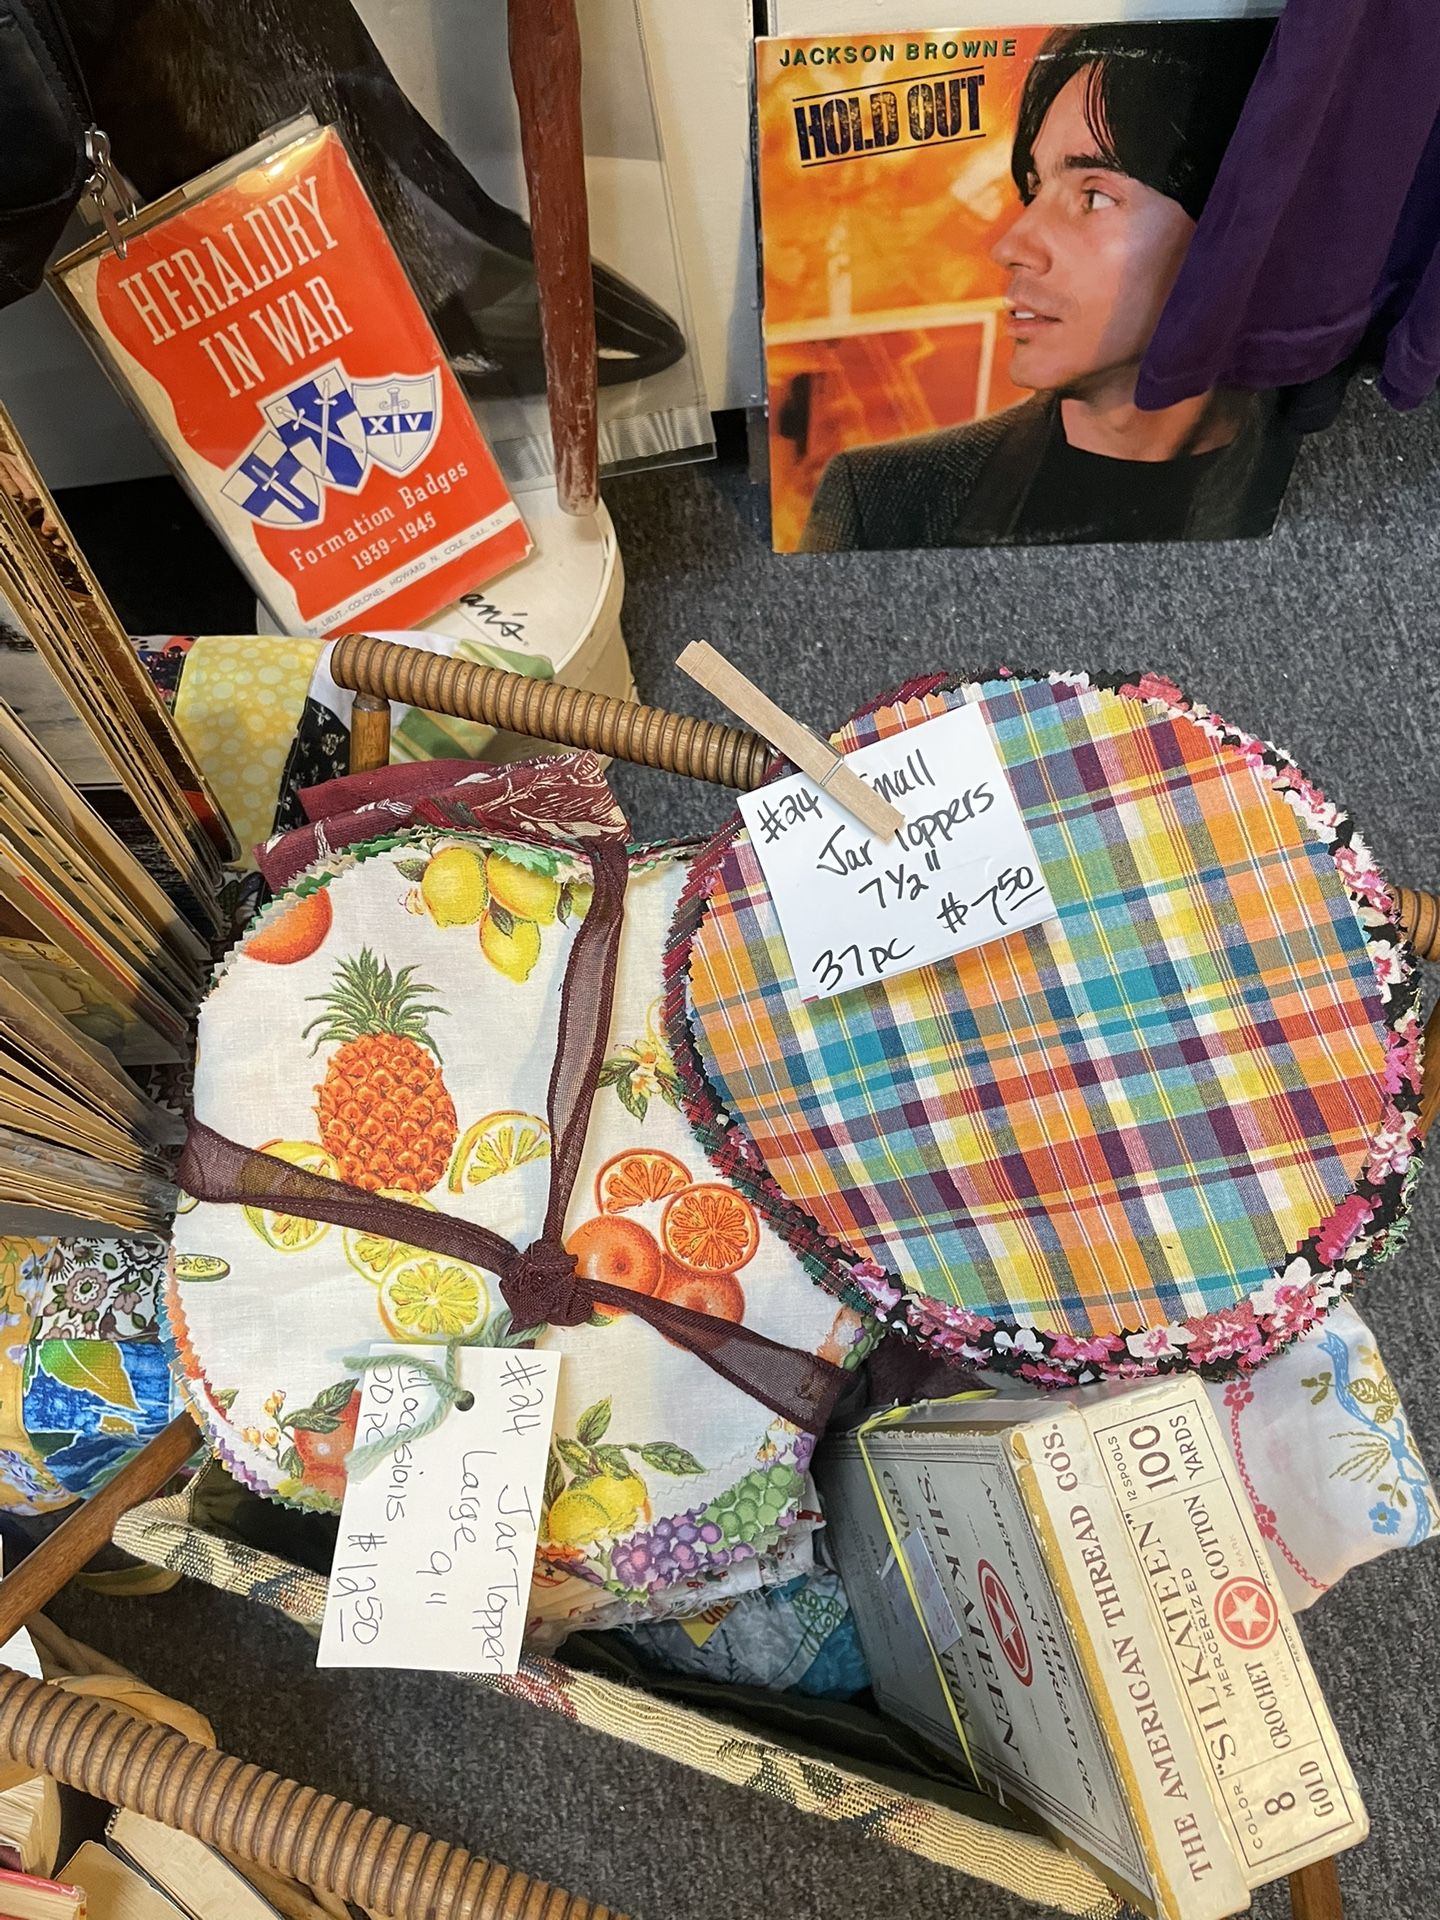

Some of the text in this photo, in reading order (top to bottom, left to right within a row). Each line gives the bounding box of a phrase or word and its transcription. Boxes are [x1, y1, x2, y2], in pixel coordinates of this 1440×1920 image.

[779, 39, 1017, 67] JACKSON BROWNE
[794, 74, 985, 161] HOLD OUT
[117, 175, 339, 346] HERALDRY
[198, 275, 354, 399] IN WAR
[367, 413, 424, 435] XIV
[289, 461, 469, 572] Formation Badges
[389, 561, 426, 588] HOWARD
[757, 748, 936, 844] #24 mall
[816, 824, 874, 877] Jar
[1107, 1435, 1138, 1502] 12 SPOOLS
[1129, 1424, 1179, 1492] 100
[1169, 1414, 1205, 1480] YARDS
[449, 1450, 498, 1552] Large
[472, 1355, 547, 1672] #24 Jar Topper
[1070, 1504, 1126, 1630] THREAD
[979, 1476, 1038, 1623] AMERICAN
[1036, 1628, 1079, 1750] THREAD
[1042, 1612, 1072, 1689] THE
[1181, 1566, 1236, 1698] MERCERIZED
[1183, 1494, 1292, 1750] CROCHET COTTON
[1111, 1635, 1189, 1802] AMERICAN
[1233, 1782, 1263, 1850] COLOR
[1264, 1790, 1296, 1817] 8
[1298, 1760, 1336, 1819] GOLD
[1173, 1812, 1214, 1883] THE
